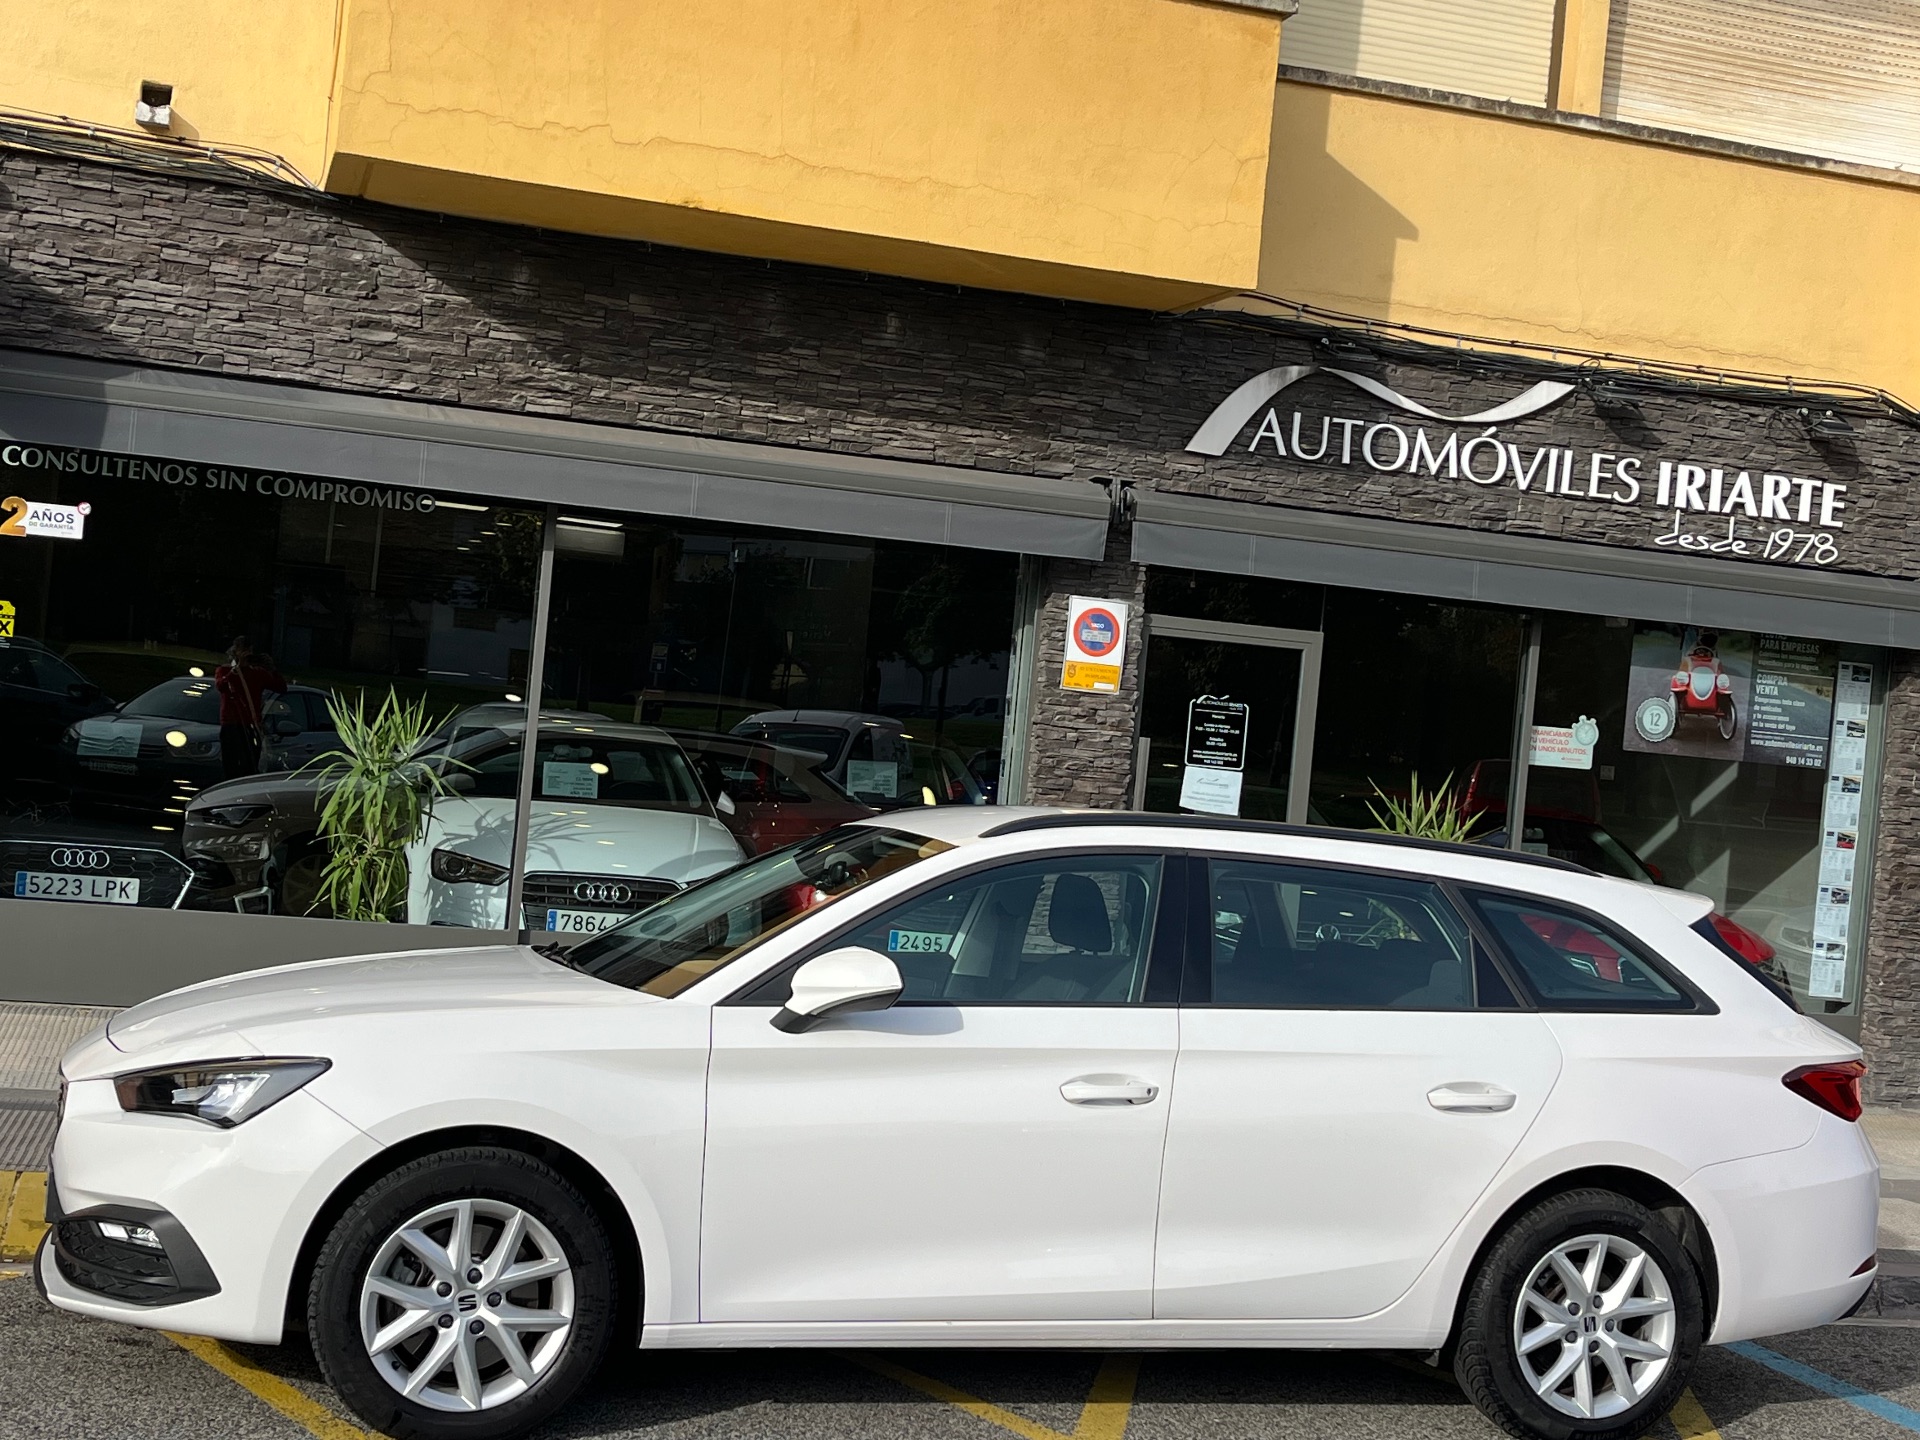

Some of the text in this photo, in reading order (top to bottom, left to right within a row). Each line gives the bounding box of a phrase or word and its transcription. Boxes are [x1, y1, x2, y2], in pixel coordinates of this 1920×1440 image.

[1248, 407, 1847, 528] AUTOMÓVILES IRIARTE
[205, 468, 248, 492] SIN
[256, 475, 436, 513] COMPROMISO
[0, 496, 74, 537] 2 AÑOS
[1654, 509, 1839, 564] desde 1978
[1760, 639, 1820, 655] PARA EMPRESAS
[1756, 673, 1788, 687] COMPRA
[1755, 685, 1779, 696] VENTA
[1649, 712, 1662, 727] 12
[28, 876, 131, 899] 5223 LPK
[560, 914, 607, 932] 7864
[900, 934, 943, 952] 2495
